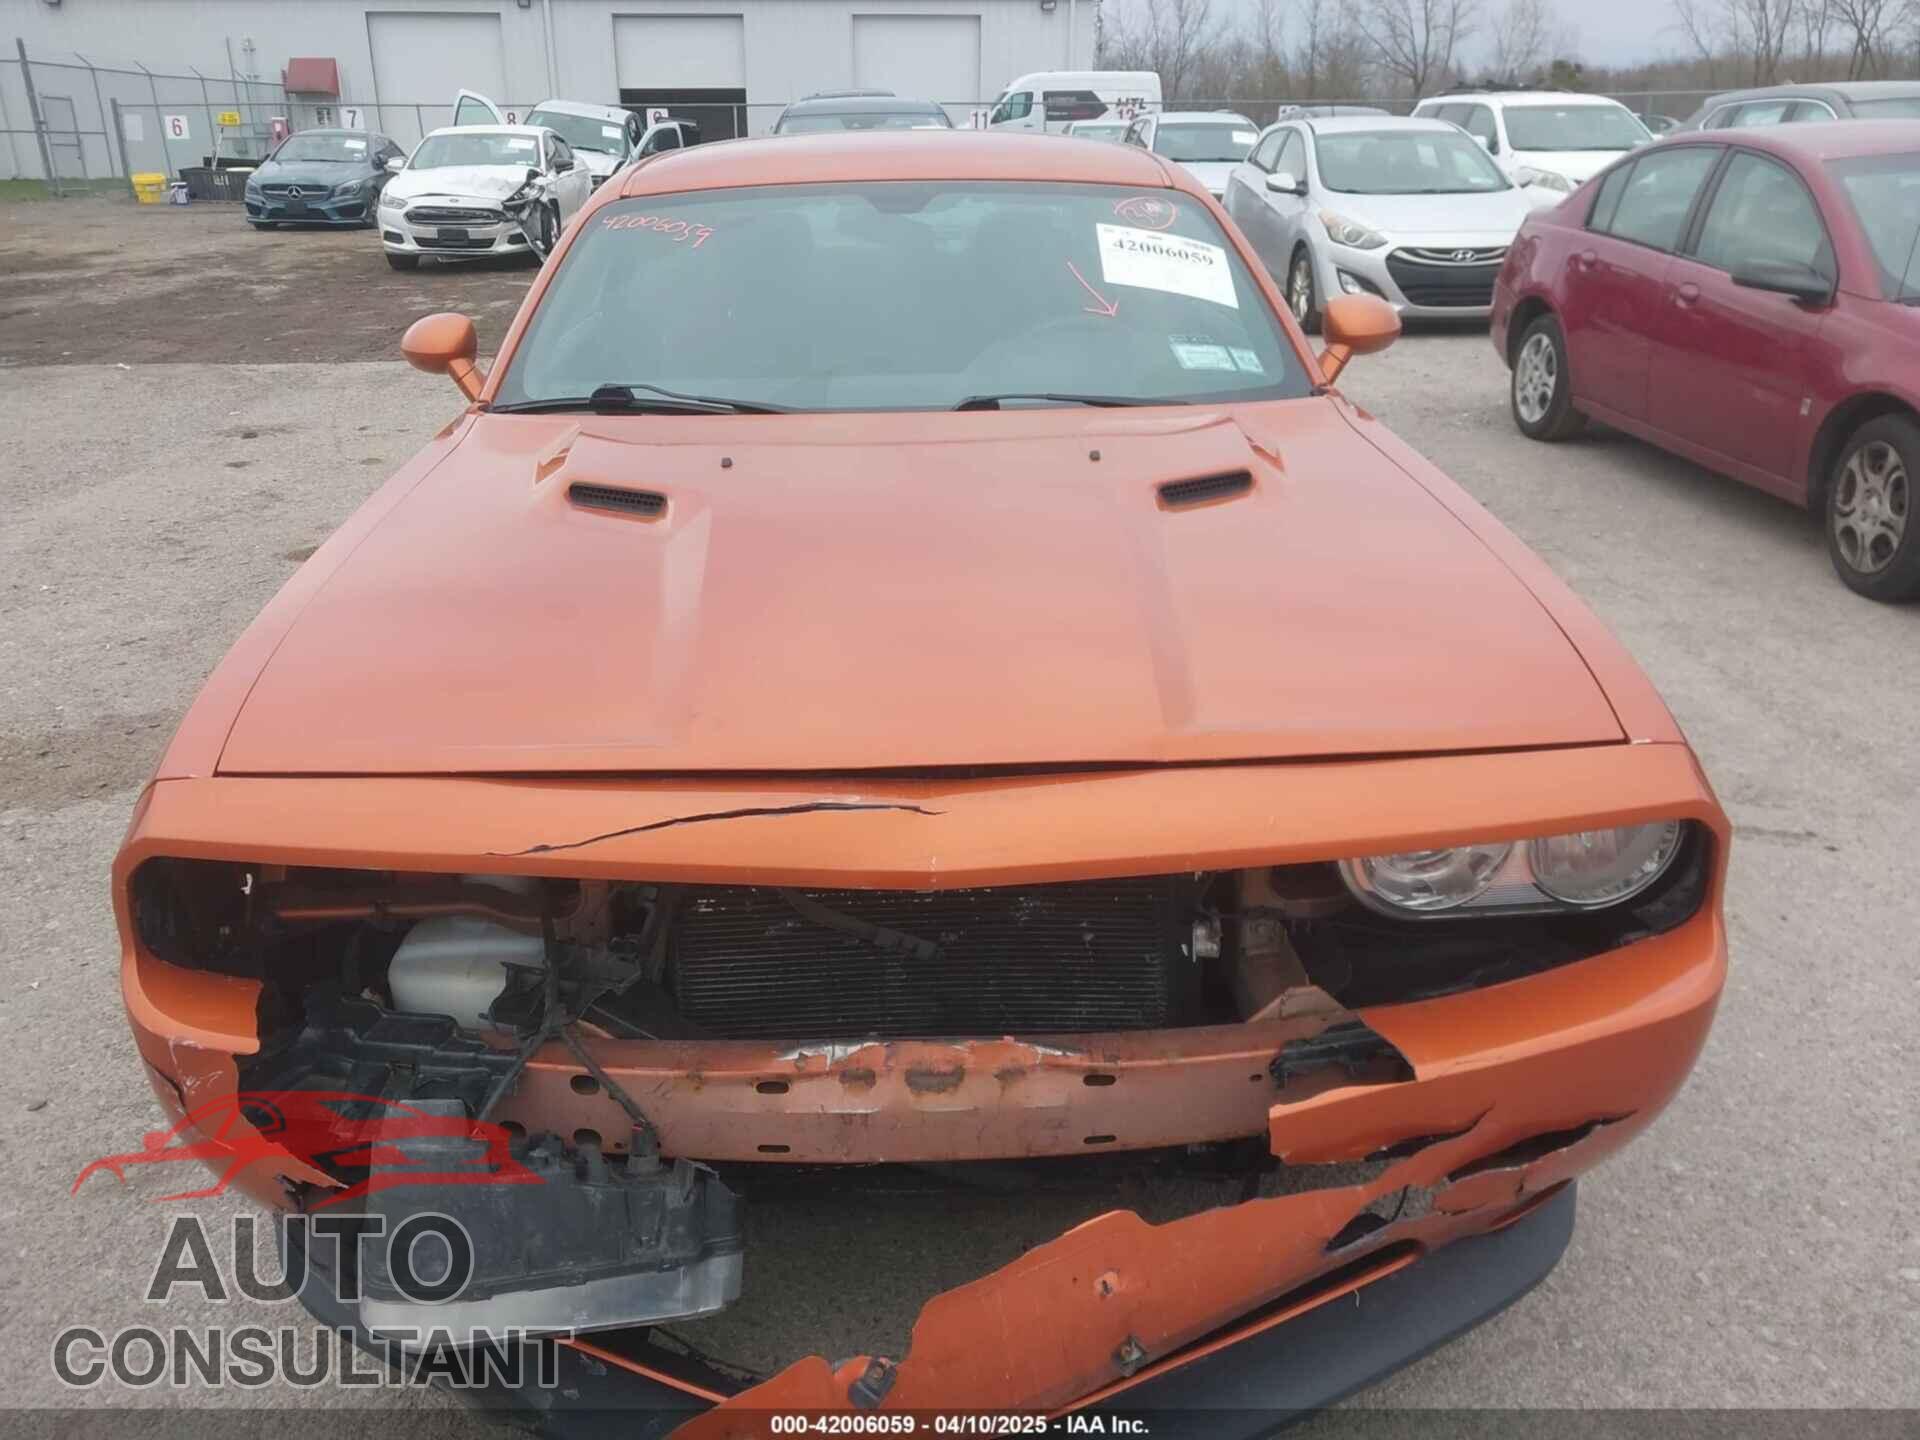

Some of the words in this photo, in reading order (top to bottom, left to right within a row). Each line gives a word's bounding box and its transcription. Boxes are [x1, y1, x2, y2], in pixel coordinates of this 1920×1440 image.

[172, 117, 183, 137] 6
[347, 109, 357, 128] 7
[972, 111, 988, 129] 11
[602, 215, 716, 249] 42006059
[1112, 238, 1215, 266] 42006059
